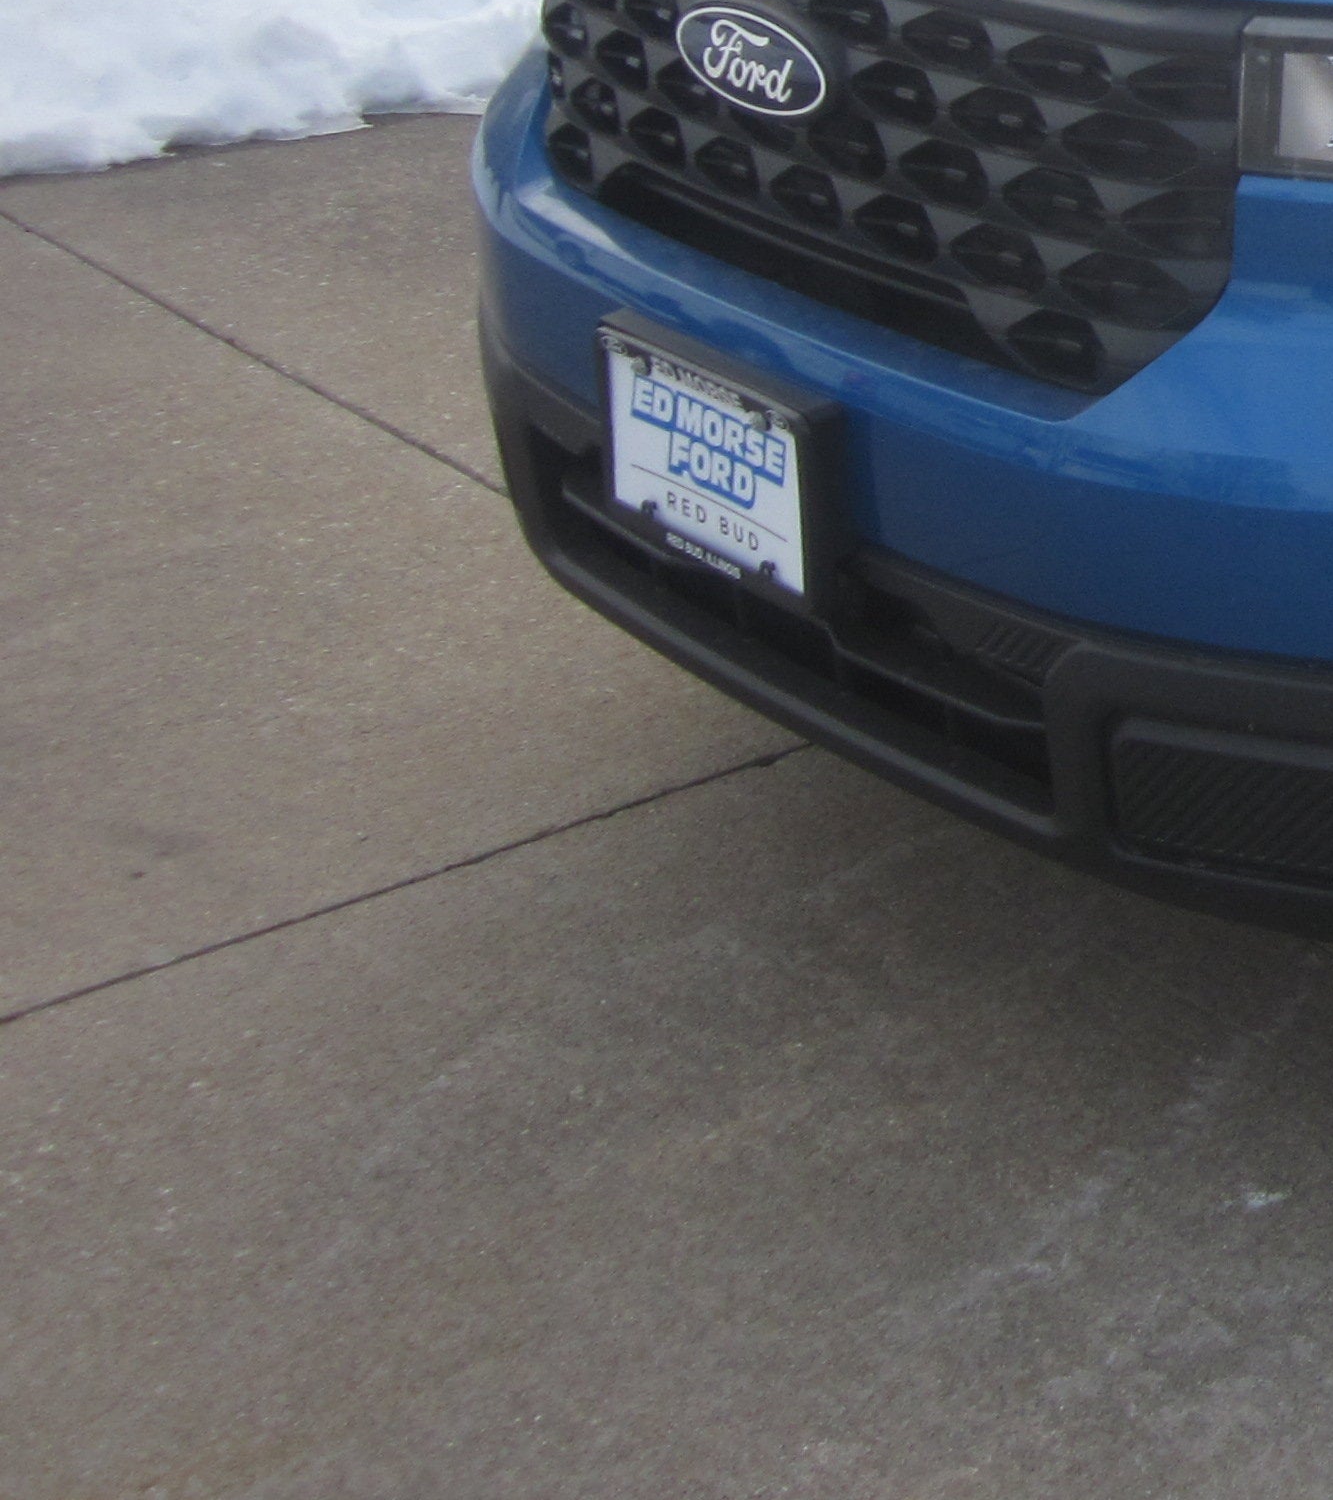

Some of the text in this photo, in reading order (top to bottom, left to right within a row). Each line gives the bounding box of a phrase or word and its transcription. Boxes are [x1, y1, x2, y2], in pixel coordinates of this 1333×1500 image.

[703, 19, 793, 102] Ford
[632, 374, 786, 488] ED MORSE
[668, 431, 756, 510] FORD
[667, 491, 759, 551] RED BUD
